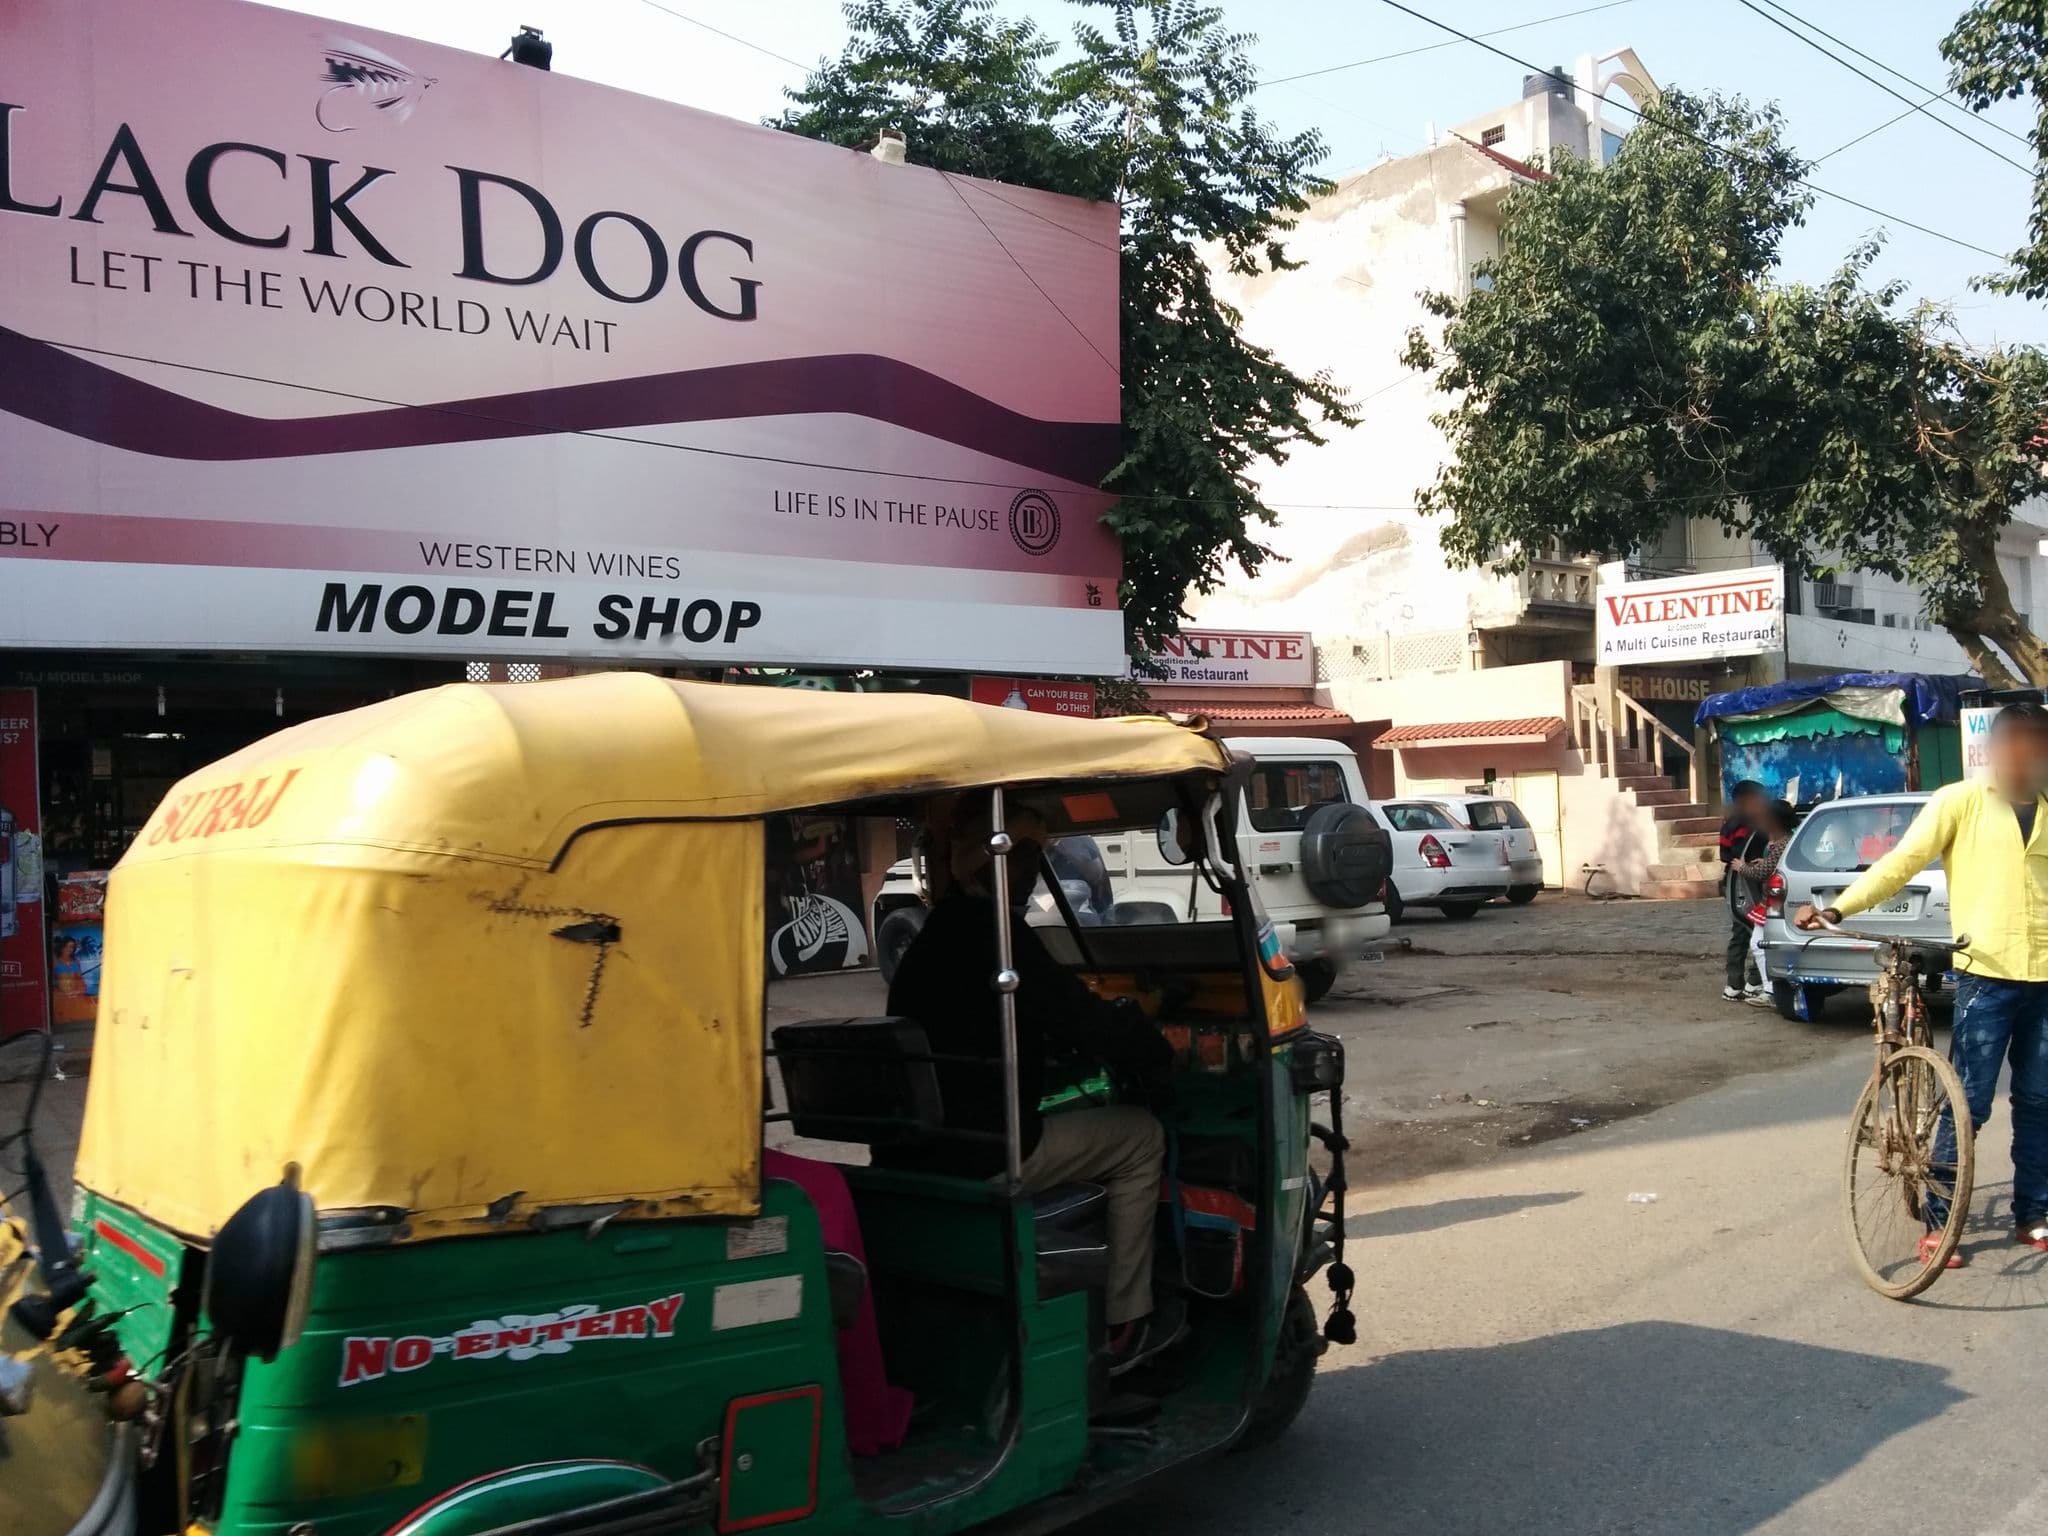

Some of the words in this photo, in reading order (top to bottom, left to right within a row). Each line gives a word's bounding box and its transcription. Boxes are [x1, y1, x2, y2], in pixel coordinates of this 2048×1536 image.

[0, 104, 411, 269] LACK
[445, 166, 763, 322] DOG
[69, 246, 162, 293] LET
[178, 260, 283, 309] THE
[300, 277, 490, 336] WORLD
[505, 307, 618, 353] WAIT
[774, 490, 818, 516] LIFE
[828, 496, 846, 518] IS
[855, 498, 877, 521] IN
[884, 501, 927, 525] THE
[935, 506, 1000, 531] PAUSE
[0, 521, 60, 547] BLY
[419, 540, 576, 574] WESTERN
[587, 552, 681, 579] WINES
[315, 584, 569, 637] MODEL
[592, 594, 761, 643] SHOP
[1605, 588, 1774, 626] VALENTINE
[1150, 634, 1304, 661] NTINE
[1604, 640, 1613, 653] A
[1617, 637, 1647, 652] Multi
[1651, 634, 1697, 649] Cuisine
[1702, 625, 1776, 644] Restaurant
[1181, 667, 1249, 681] Restaurant
[1650, 678, 1710, 700] HOUSE
[1027, 688, 1045, 698] CAN
[1046, 690, 1069, 700] YOUR
[1070, 692, 1089, 701] BEER
[1056, 702, 1068, 712] DO
[1069, 703, 1090, 713] THIS?
[342, 1337, 434, 1384] NO
[453, 1294, 684, 1358] ENTERY
